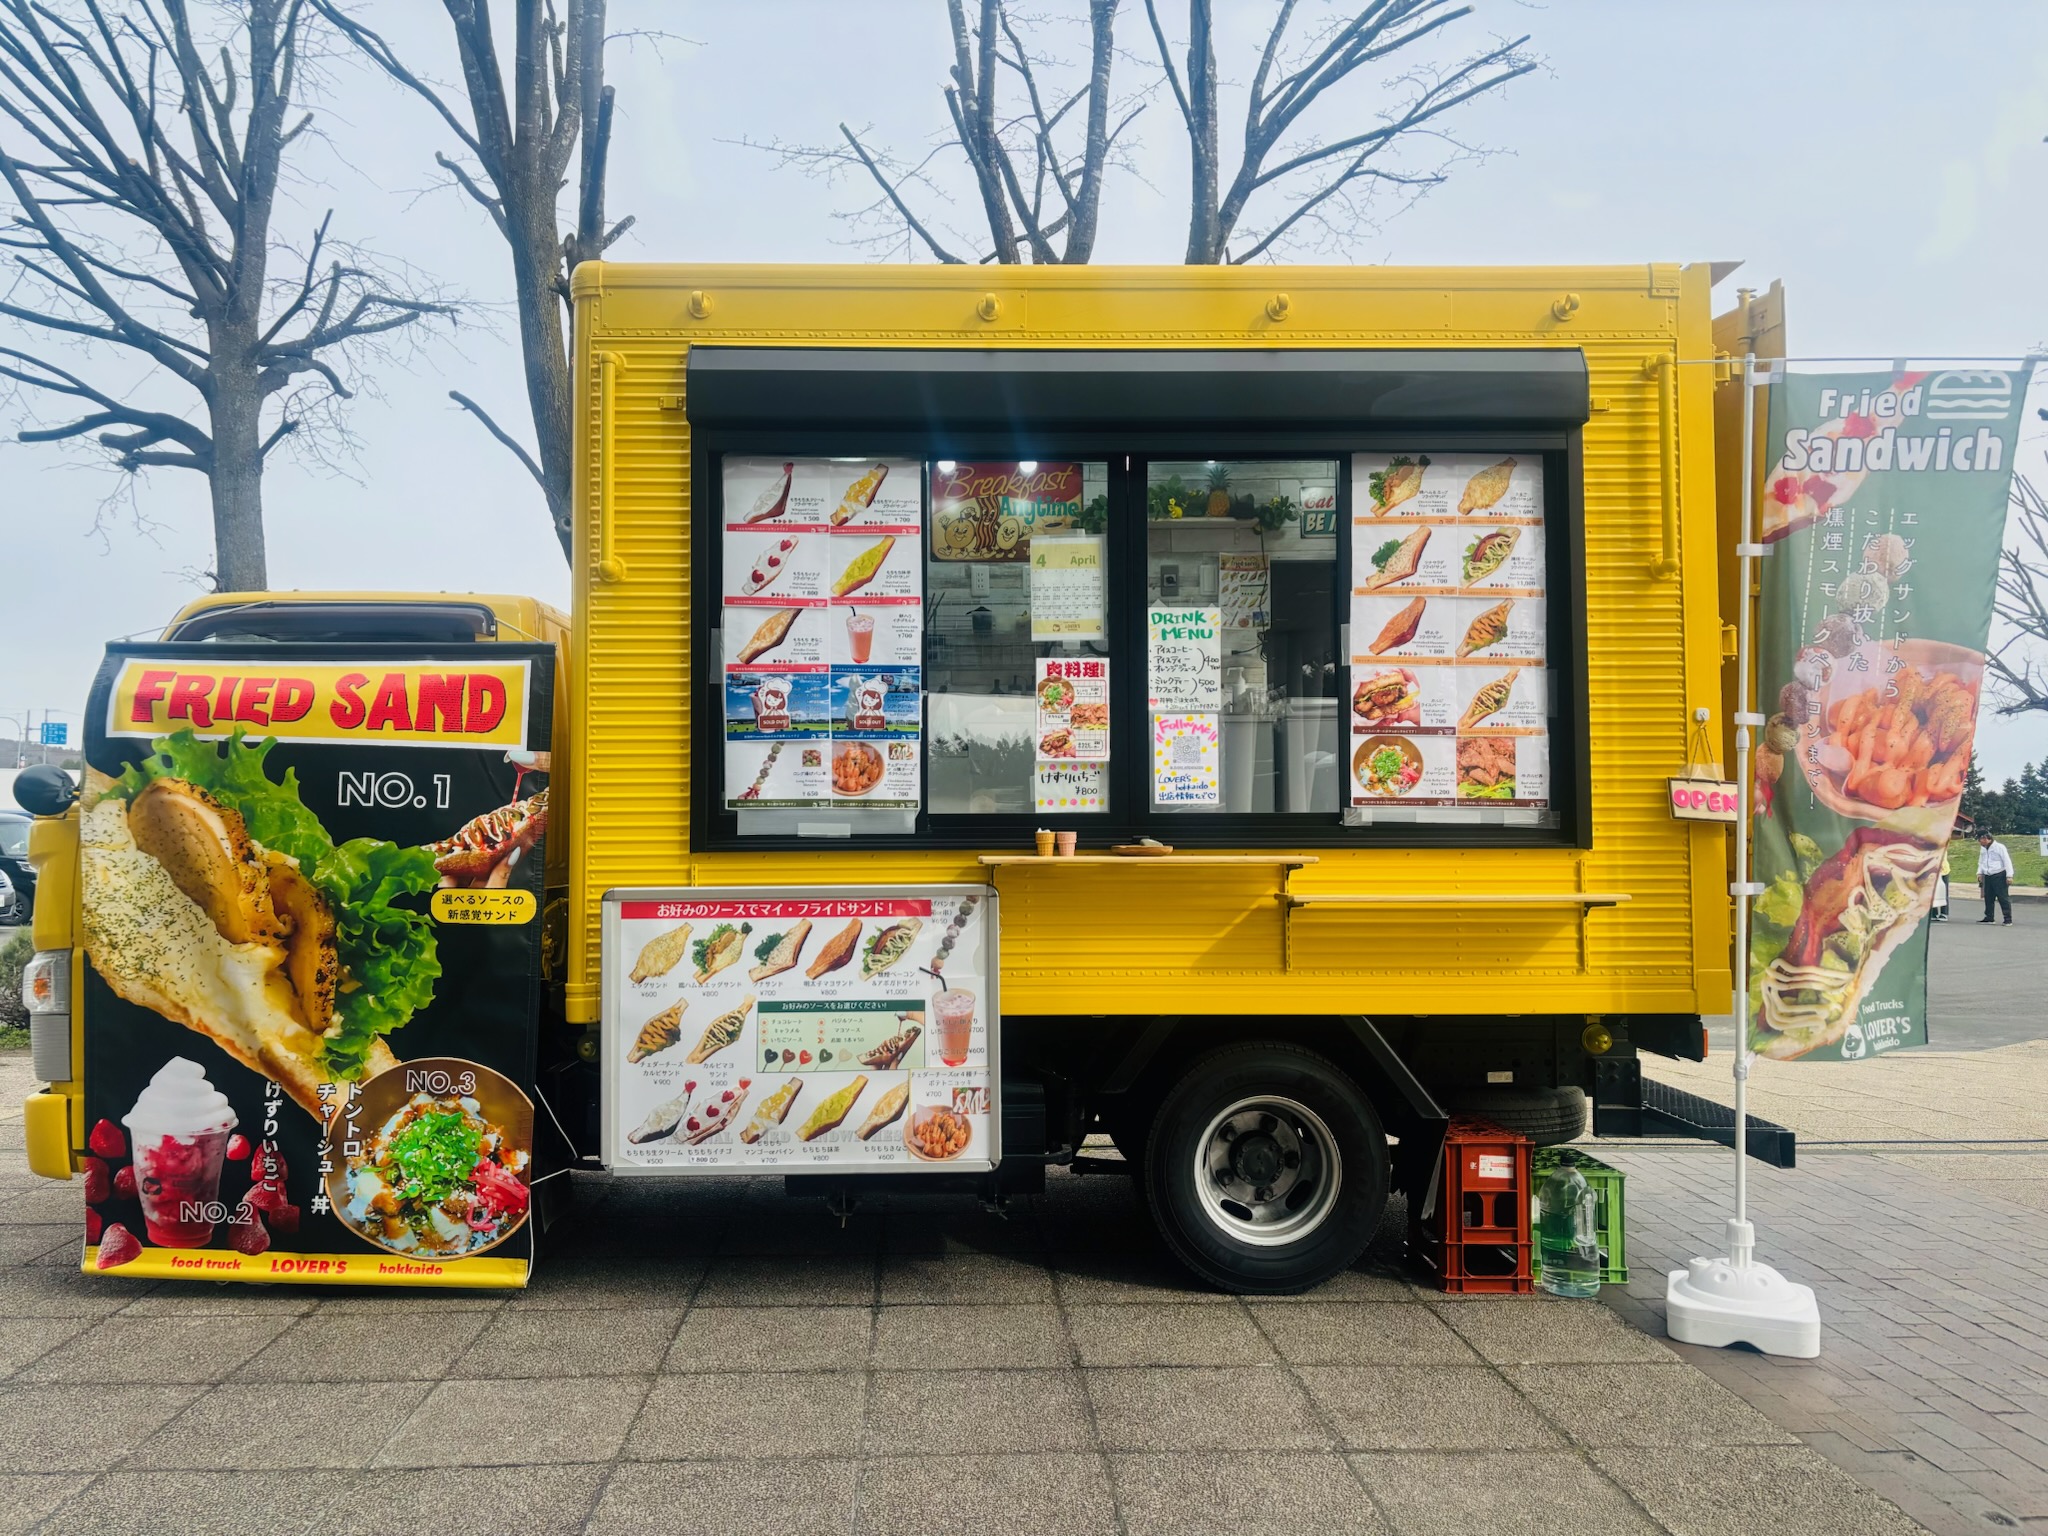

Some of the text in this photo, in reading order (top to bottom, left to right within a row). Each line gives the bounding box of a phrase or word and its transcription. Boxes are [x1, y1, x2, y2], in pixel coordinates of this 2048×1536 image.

[1818, 385, 1924, 419] Fried
[1782, 425, 2004, 473] Sandwich
[942, 465, 1073, 499] Breakfast
[1304, 495, 1334, 509] Eat
[1000, 496, 1081, 525] Anytime
[1306, 513, 1325, 531] BE
[1036, 554, 1097, 567] 4 April
[1848, 509, 1881, 672] こだわり抜いた
[1886, 512, 1918, 698] エッグサンドから
[1151, 610, 1207, 625] DRINK
[1161, 627, 1213, 640] MENU
[1155, 645, 1193, 655] アイスコーヒー
[1153, 656, 1190, 664] アイスティー
[1205, 655, 1219, 666] 400
[1046, 660, 1099, 678] 肉料理
[1154, 664, 1197, 673] オレンジジュース
[1155, 676, 1190, 685] ミルクティー
[1198, 679, 1215, 687] 500
[1155, 686, 1185, 694] カフェオレ
[130, 670, 507, 734] FRIED SAND
[1041, 771, 1101, 784] けずりいちご
[337, 770, 452, 809] NO.1
[1075, 786, 1098, 796] ¥800
[1672, 788, 1738, 813] OPEN
[441, 894, 525, 905] 選べるソースの
[447, 909, 518, 921] 新感覚サンド
[702, 990, 718, 998] ¥800
[1875, 999, 1904, 1011] Trucks
[1864, 1016, 1912, 1041] LOVER'S
[405, 1069, 477, 1095] NO.3
[343, 1082, 363, 1158] トントロ
[262, 1081, 284, 1192] けずりいちご
[311, 1082, 337, 1216] チャーシュー丼
[179, 1201, 254, 1225] NO.2
[171, 1256, 242, 1270] food truck
[271, 1259, 348, 1275] LOVER'S
[378, 1263, 443, 1275] hokkaido
